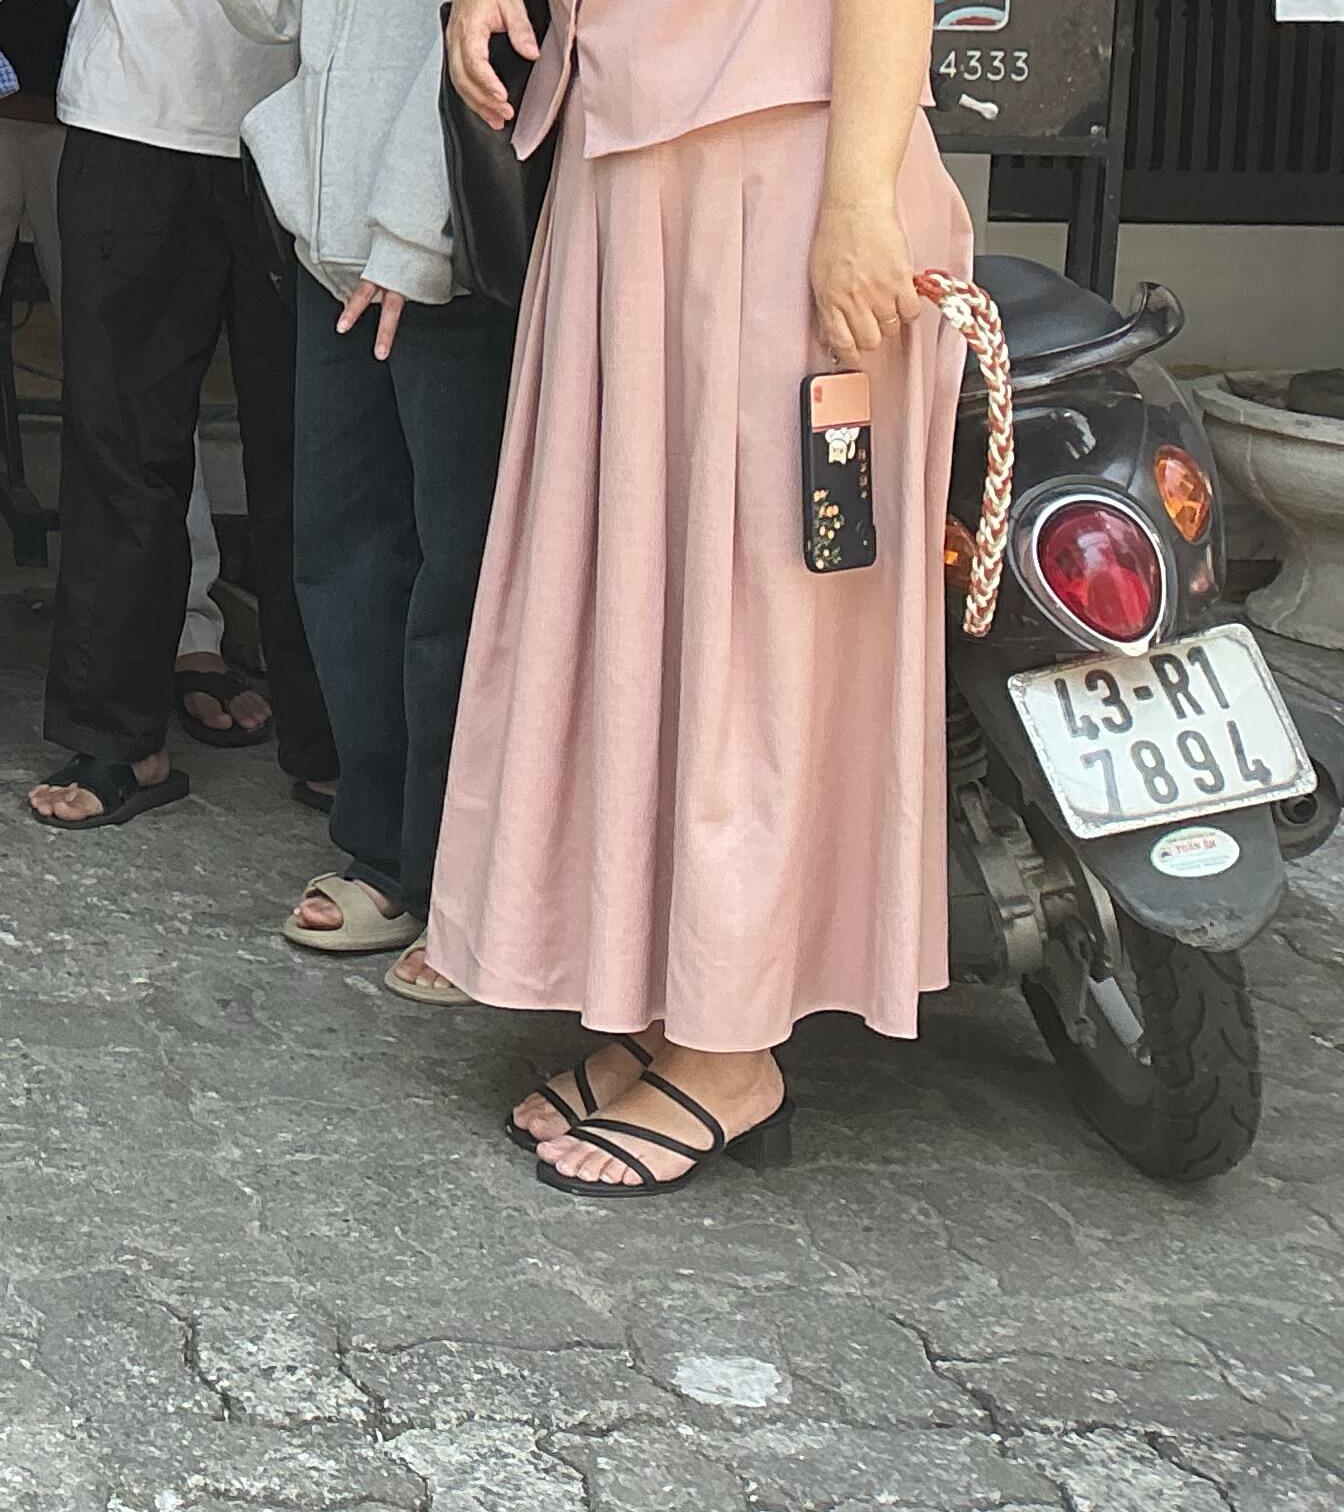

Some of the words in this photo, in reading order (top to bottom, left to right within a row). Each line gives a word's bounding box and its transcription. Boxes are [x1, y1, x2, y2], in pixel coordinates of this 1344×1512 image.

[939, 49, 1030, 84] 4333
[1054, 647, 1231, 740] 43-R1
[1081, 720, 1273, 816] 7894
